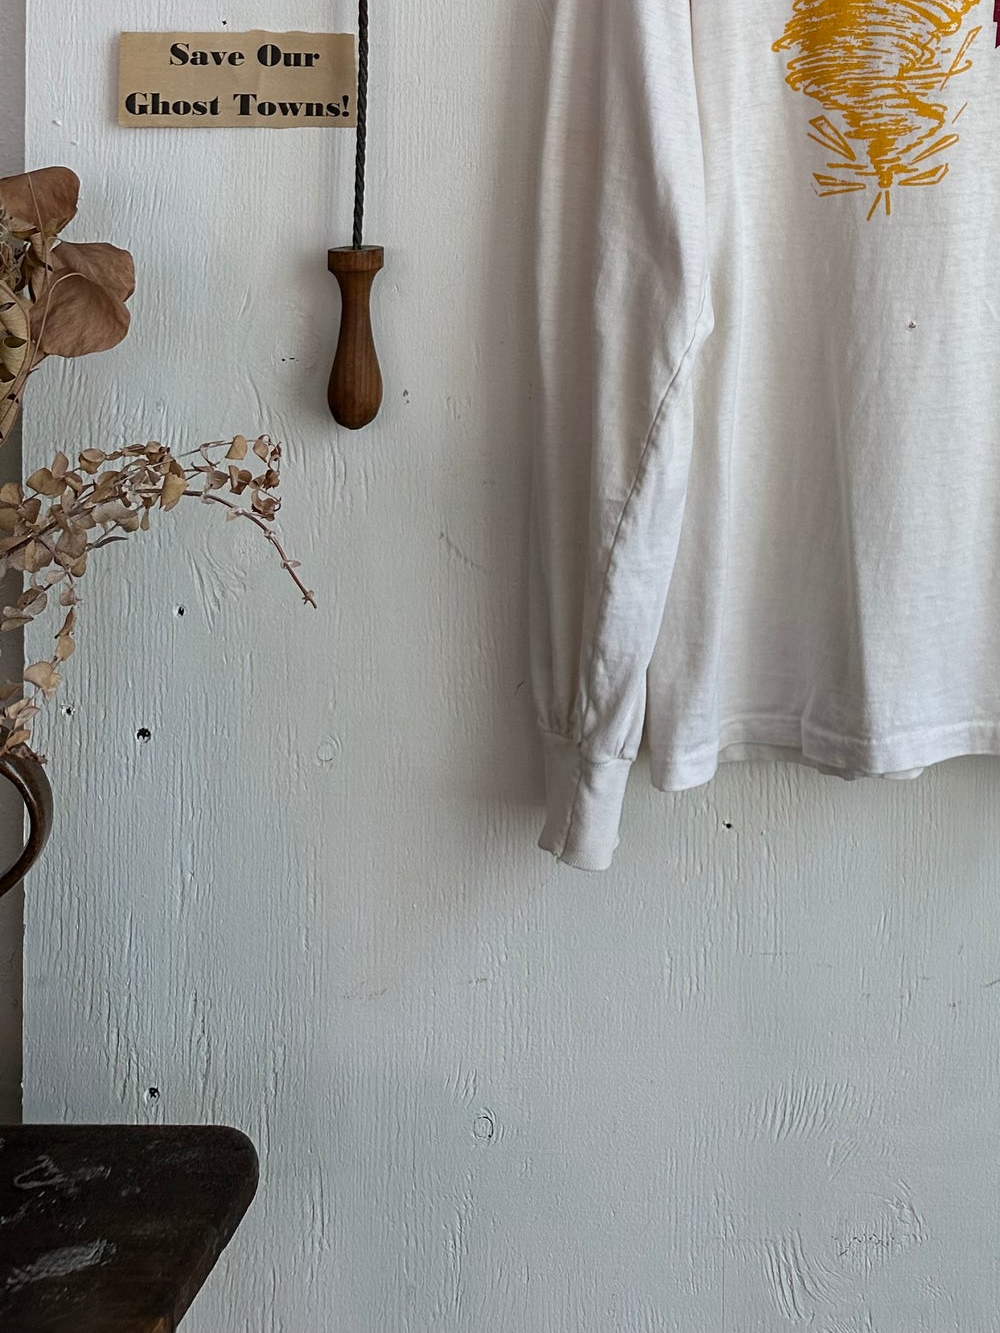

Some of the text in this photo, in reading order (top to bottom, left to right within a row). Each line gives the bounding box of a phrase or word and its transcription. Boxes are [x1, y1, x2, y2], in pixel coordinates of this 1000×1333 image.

[169, 42, 320, 68] Save Our
[124, 92, 350, 117] Ghost Towns!
